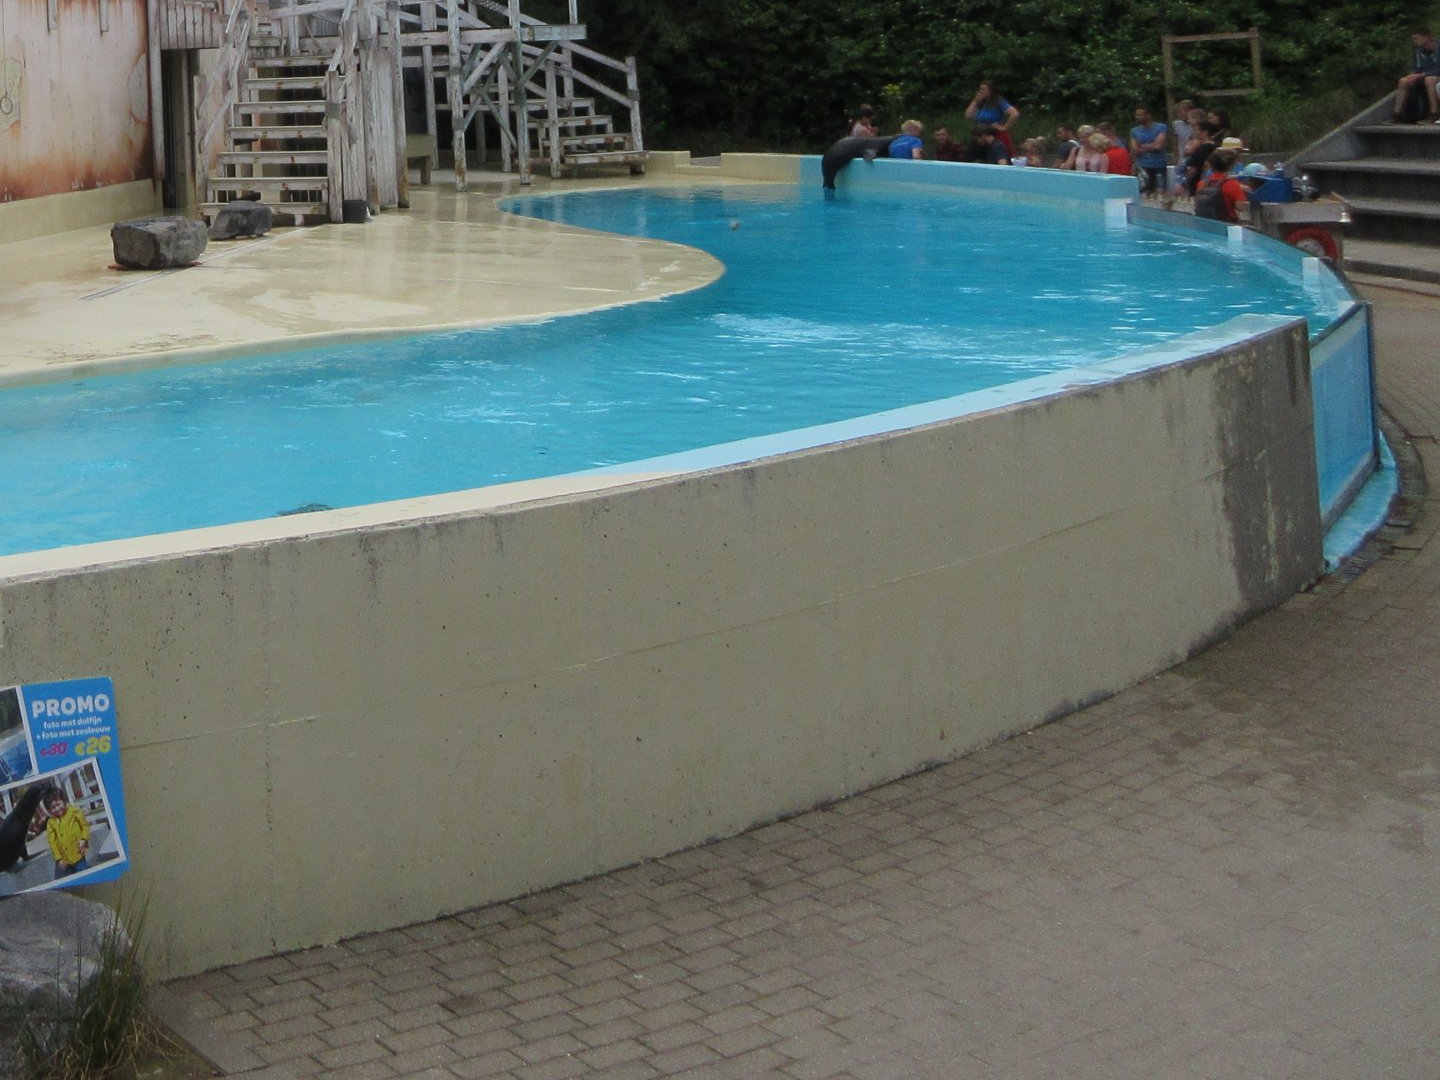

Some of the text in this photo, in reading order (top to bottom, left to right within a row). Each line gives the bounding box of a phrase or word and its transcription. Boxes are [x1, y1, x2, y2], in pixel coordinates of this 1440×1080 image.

[32, 694, 110, 718] PROMO
[43, 716, 102, 729] foto met dolfijn
[41, 731, 59, 739] foto
[59, 729, 75, 737] met
[74, 735, 112, 757] €26
